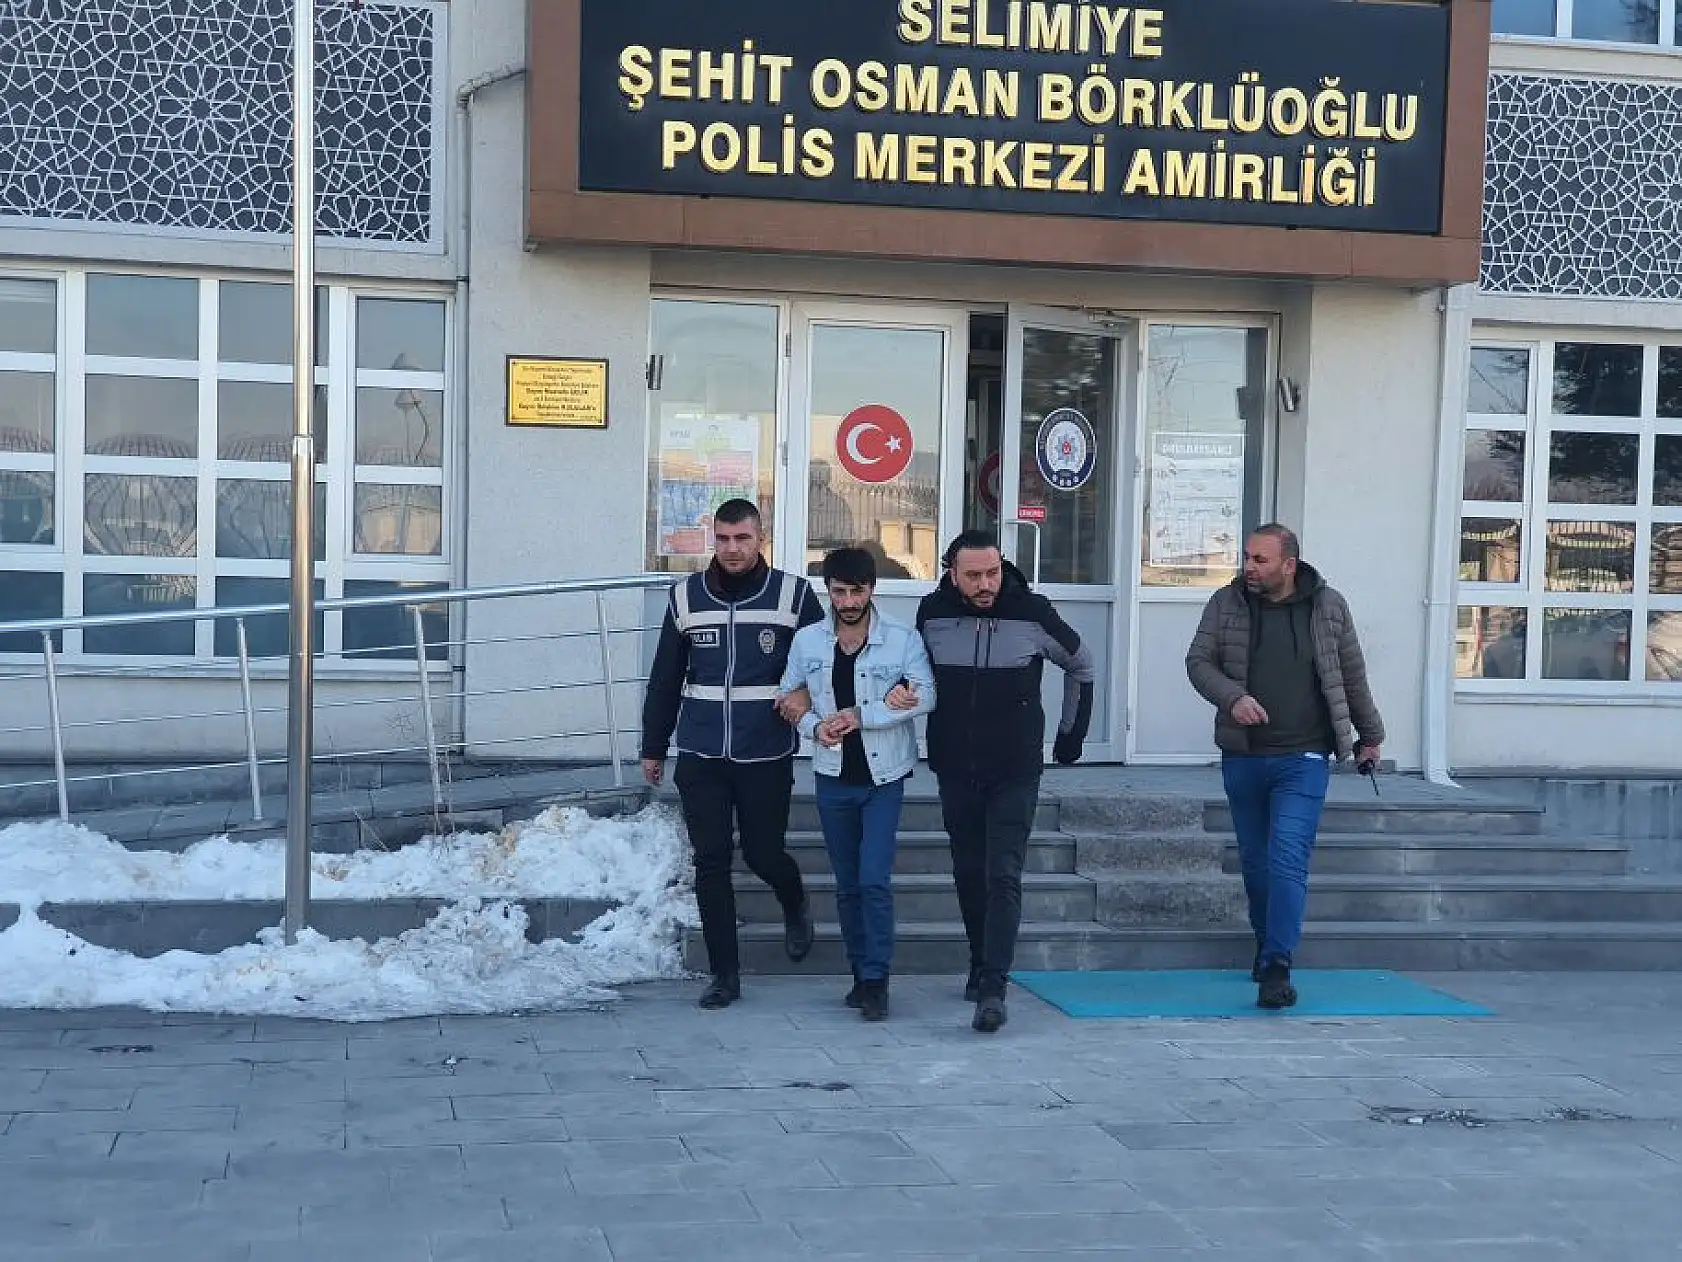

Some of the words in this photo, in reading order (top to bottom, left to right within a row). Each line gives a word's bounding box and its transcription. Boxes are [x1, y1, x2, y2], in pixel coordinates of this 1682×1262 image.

[619, 39, 794, 110] ŞEHİT
[810, 58, 1019, 118] OSMAN
[1038, 63, 1418, 141] BÖRKLÜOĞLU
[661, 114, 835, 178] POLİS
[854, 131, 1106, 193] MERKEZİ
[1122, 139, 1377, 207] AMİRLİĞİ
